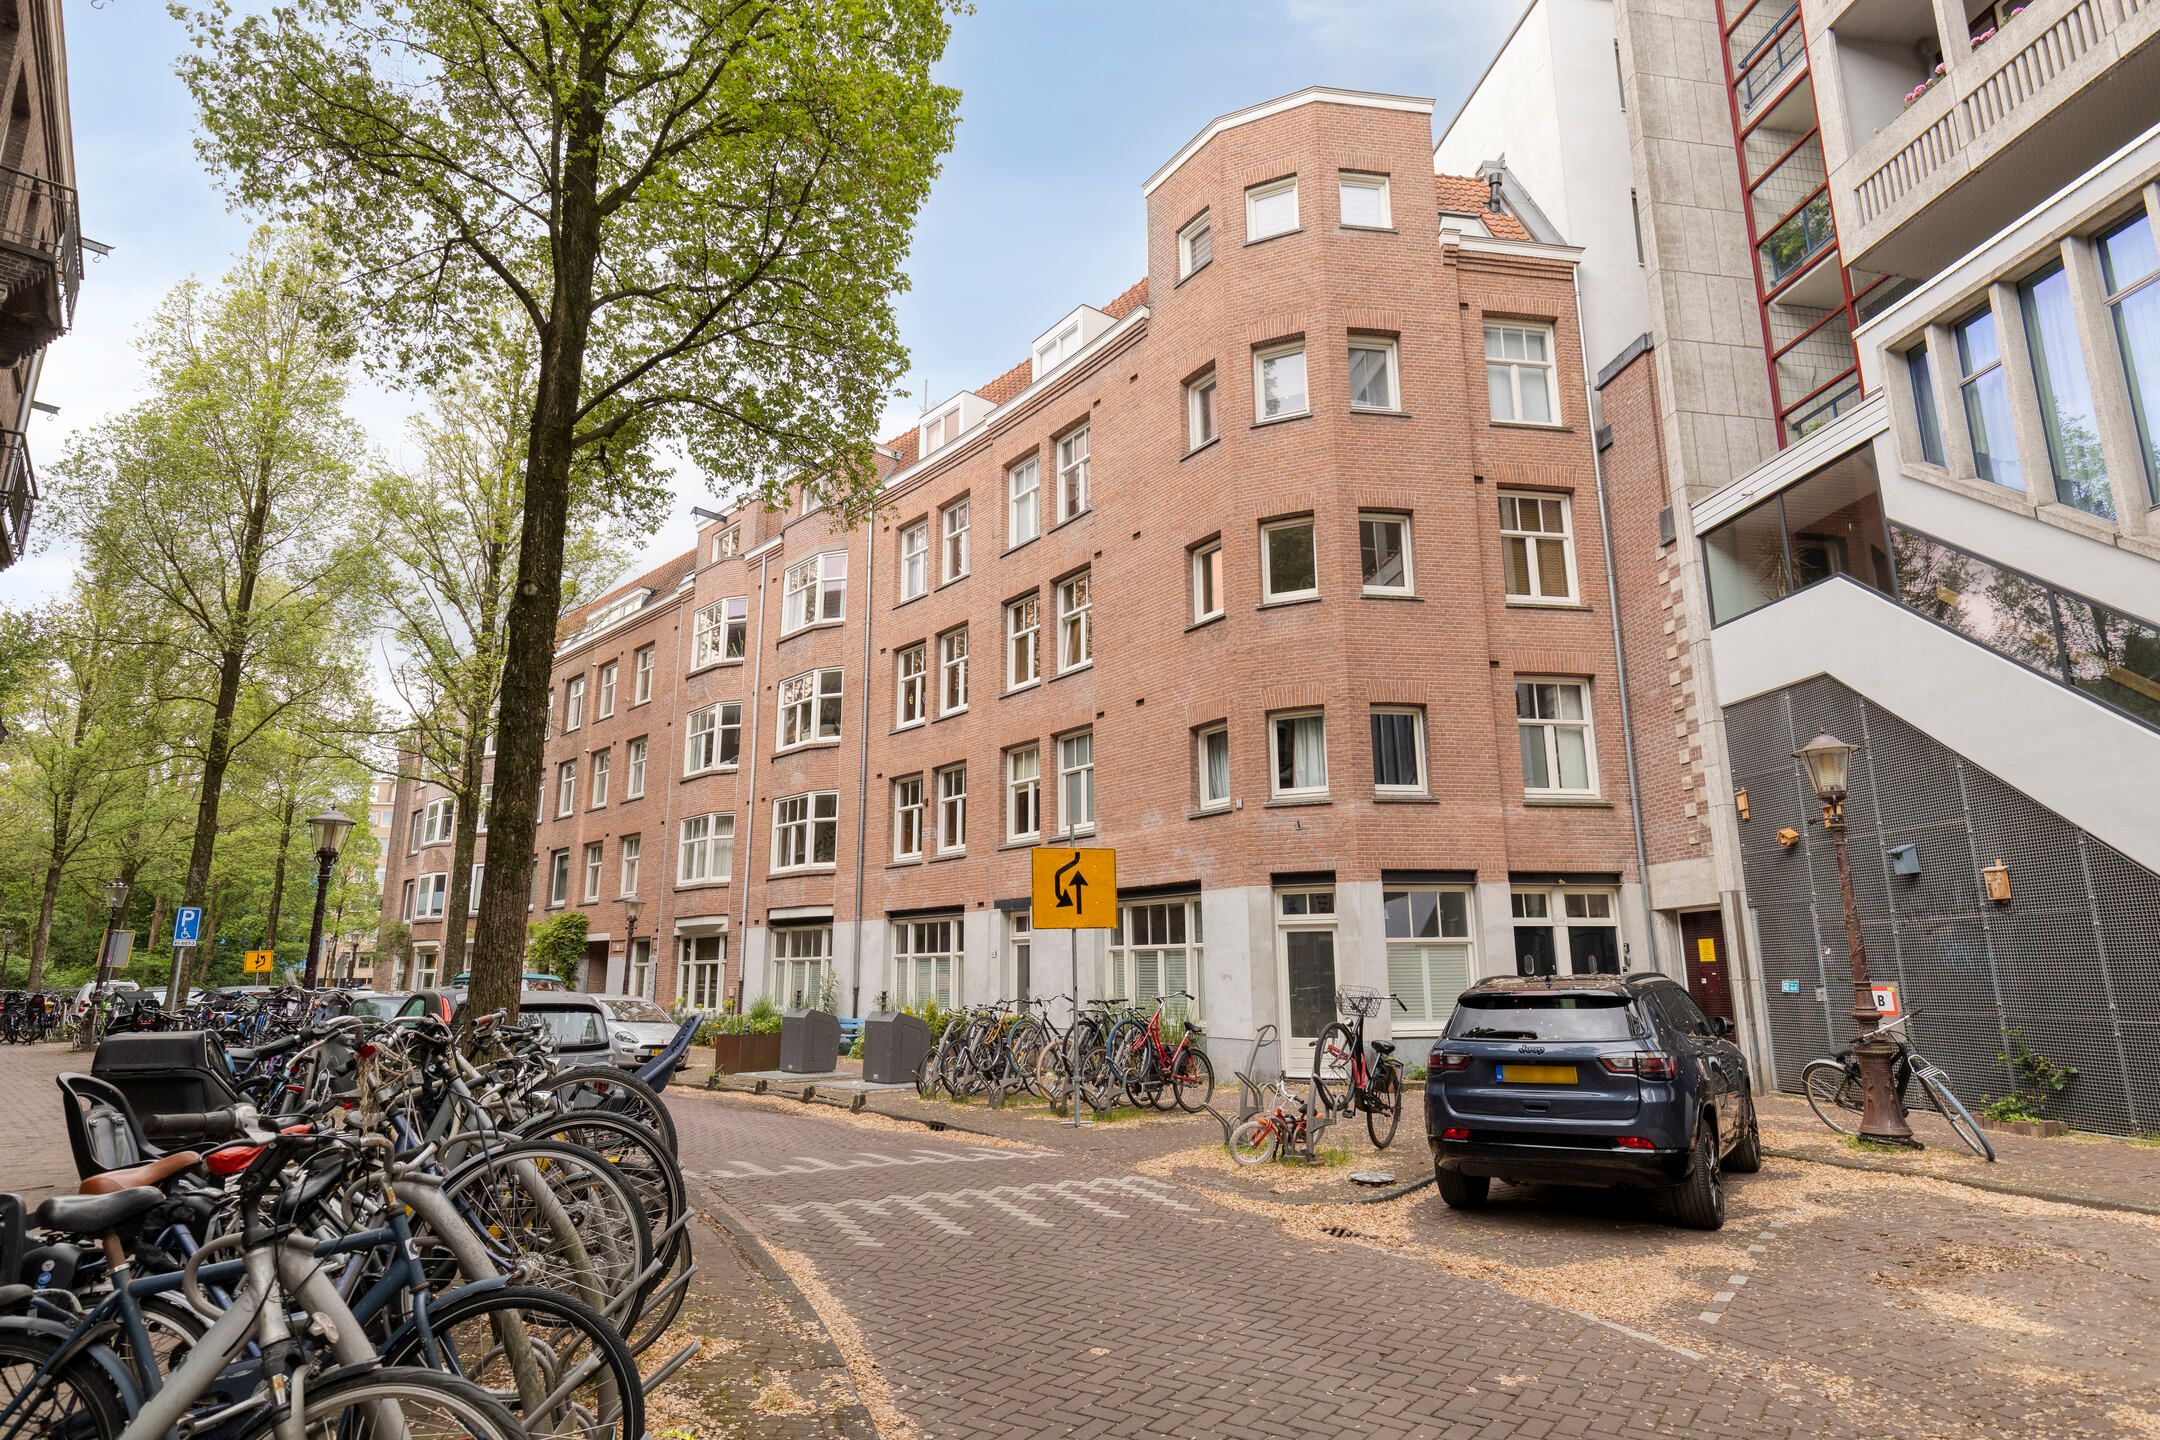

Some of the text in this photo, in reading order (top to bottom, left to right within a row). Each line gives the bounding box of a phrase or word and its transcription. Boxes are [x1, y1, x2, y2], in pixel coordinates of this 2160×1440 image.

[182, 910, 195, 926] P
[1878, 995, 1886, 1006] B
[1518, 1044, 1545, 1055] Jeep
